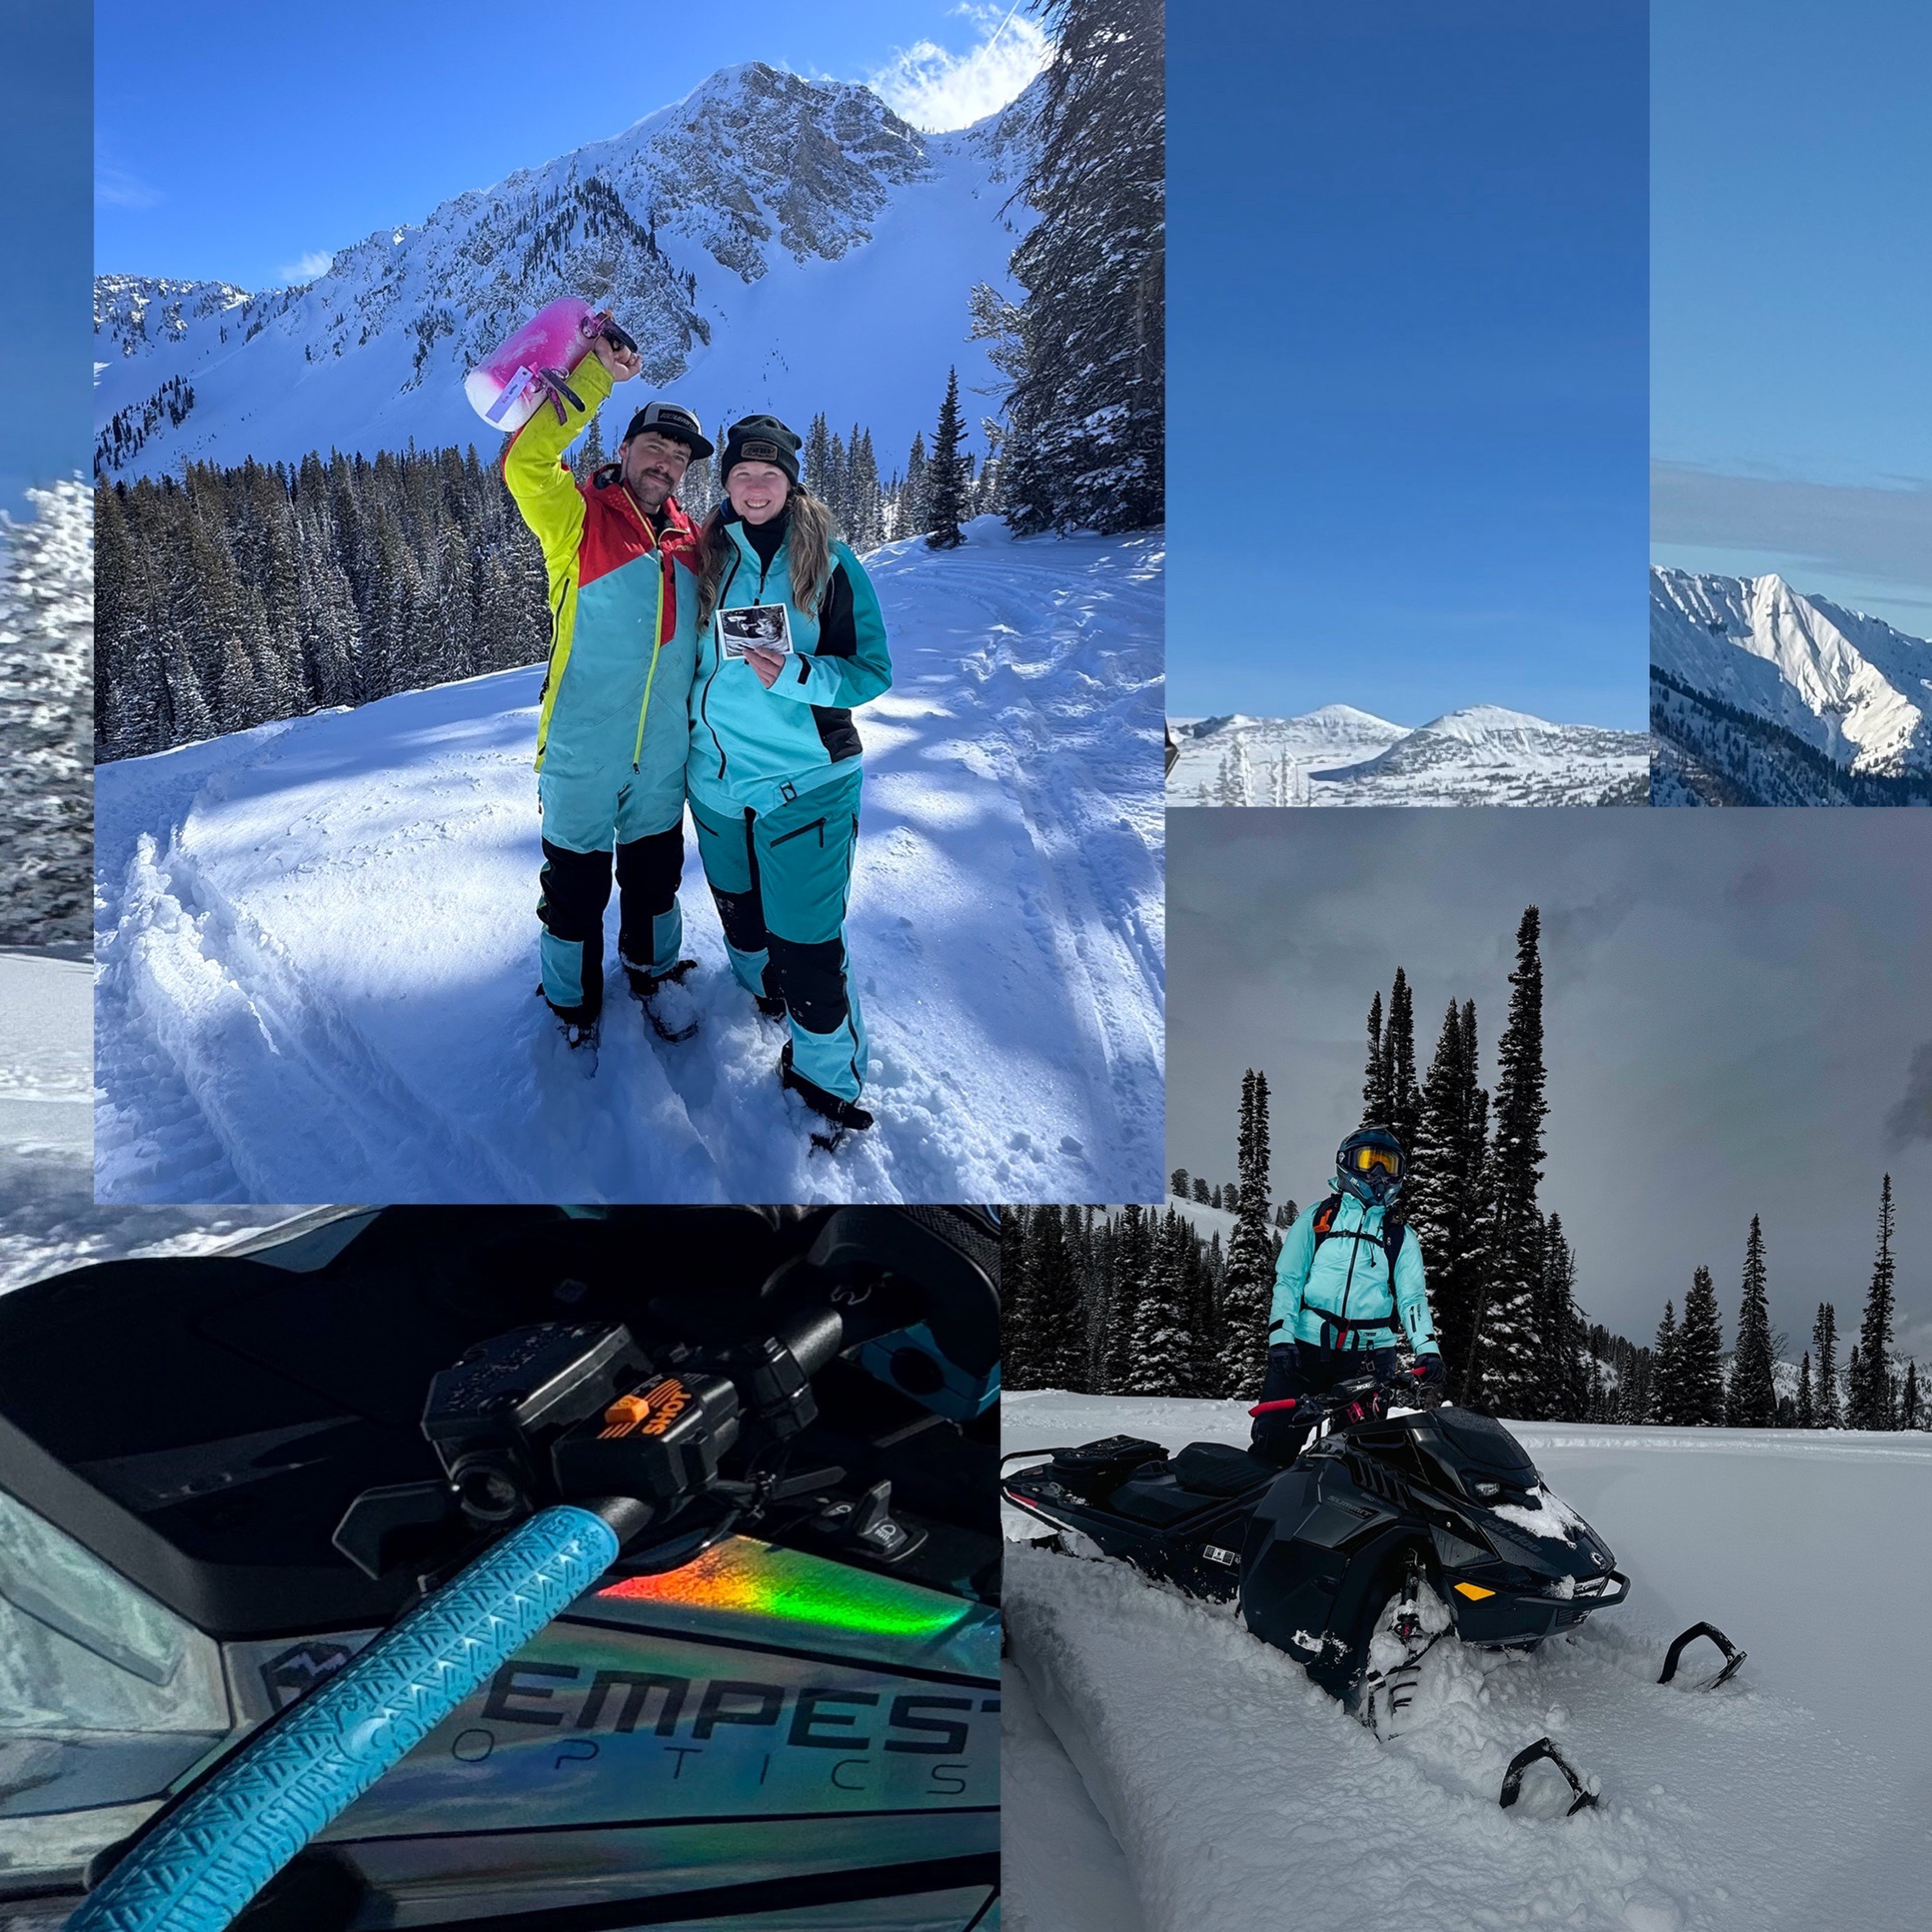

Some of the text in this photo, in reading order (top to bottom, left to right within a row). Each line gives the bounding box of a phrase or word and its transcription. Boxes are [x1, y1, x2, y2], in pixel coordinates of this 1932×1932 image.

[642, 1391, 691, 1435] SHOT
[1327, 1495, 1373, 1516] SUMMIT
[480, 1660, 1000, 1755] EMPES
[451, 1728, 968, 1795] OPTICS
